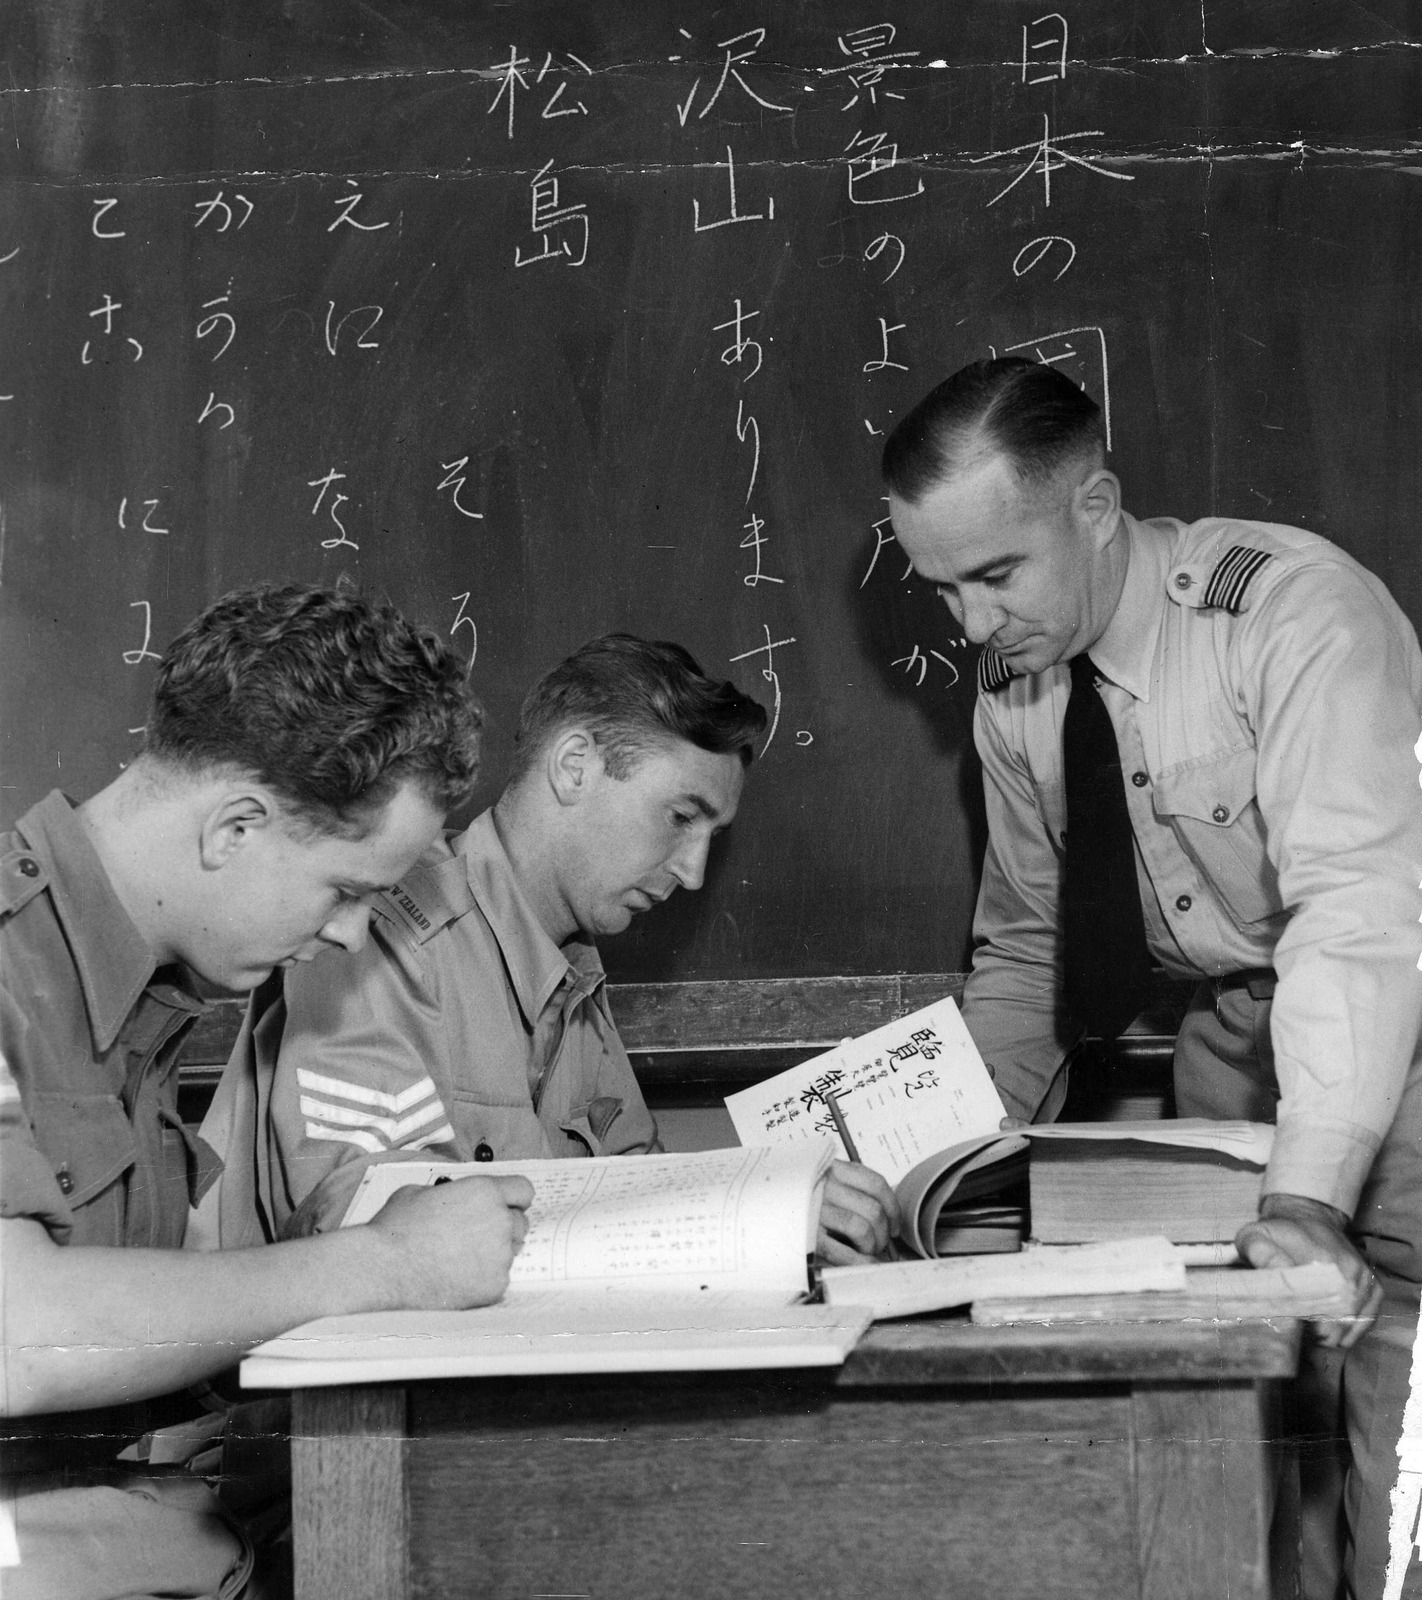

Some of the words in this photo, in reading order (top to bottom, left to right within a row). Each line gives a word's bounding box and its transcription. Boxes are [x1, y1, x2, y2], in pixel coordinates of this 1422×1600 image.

[488, 45, 592, 267] 松島
[972, 13, 1135, 452] 日本の
[668, 27, 814, 760] 沢山あります。
[398, 894, 432, 931] ZEALAND
